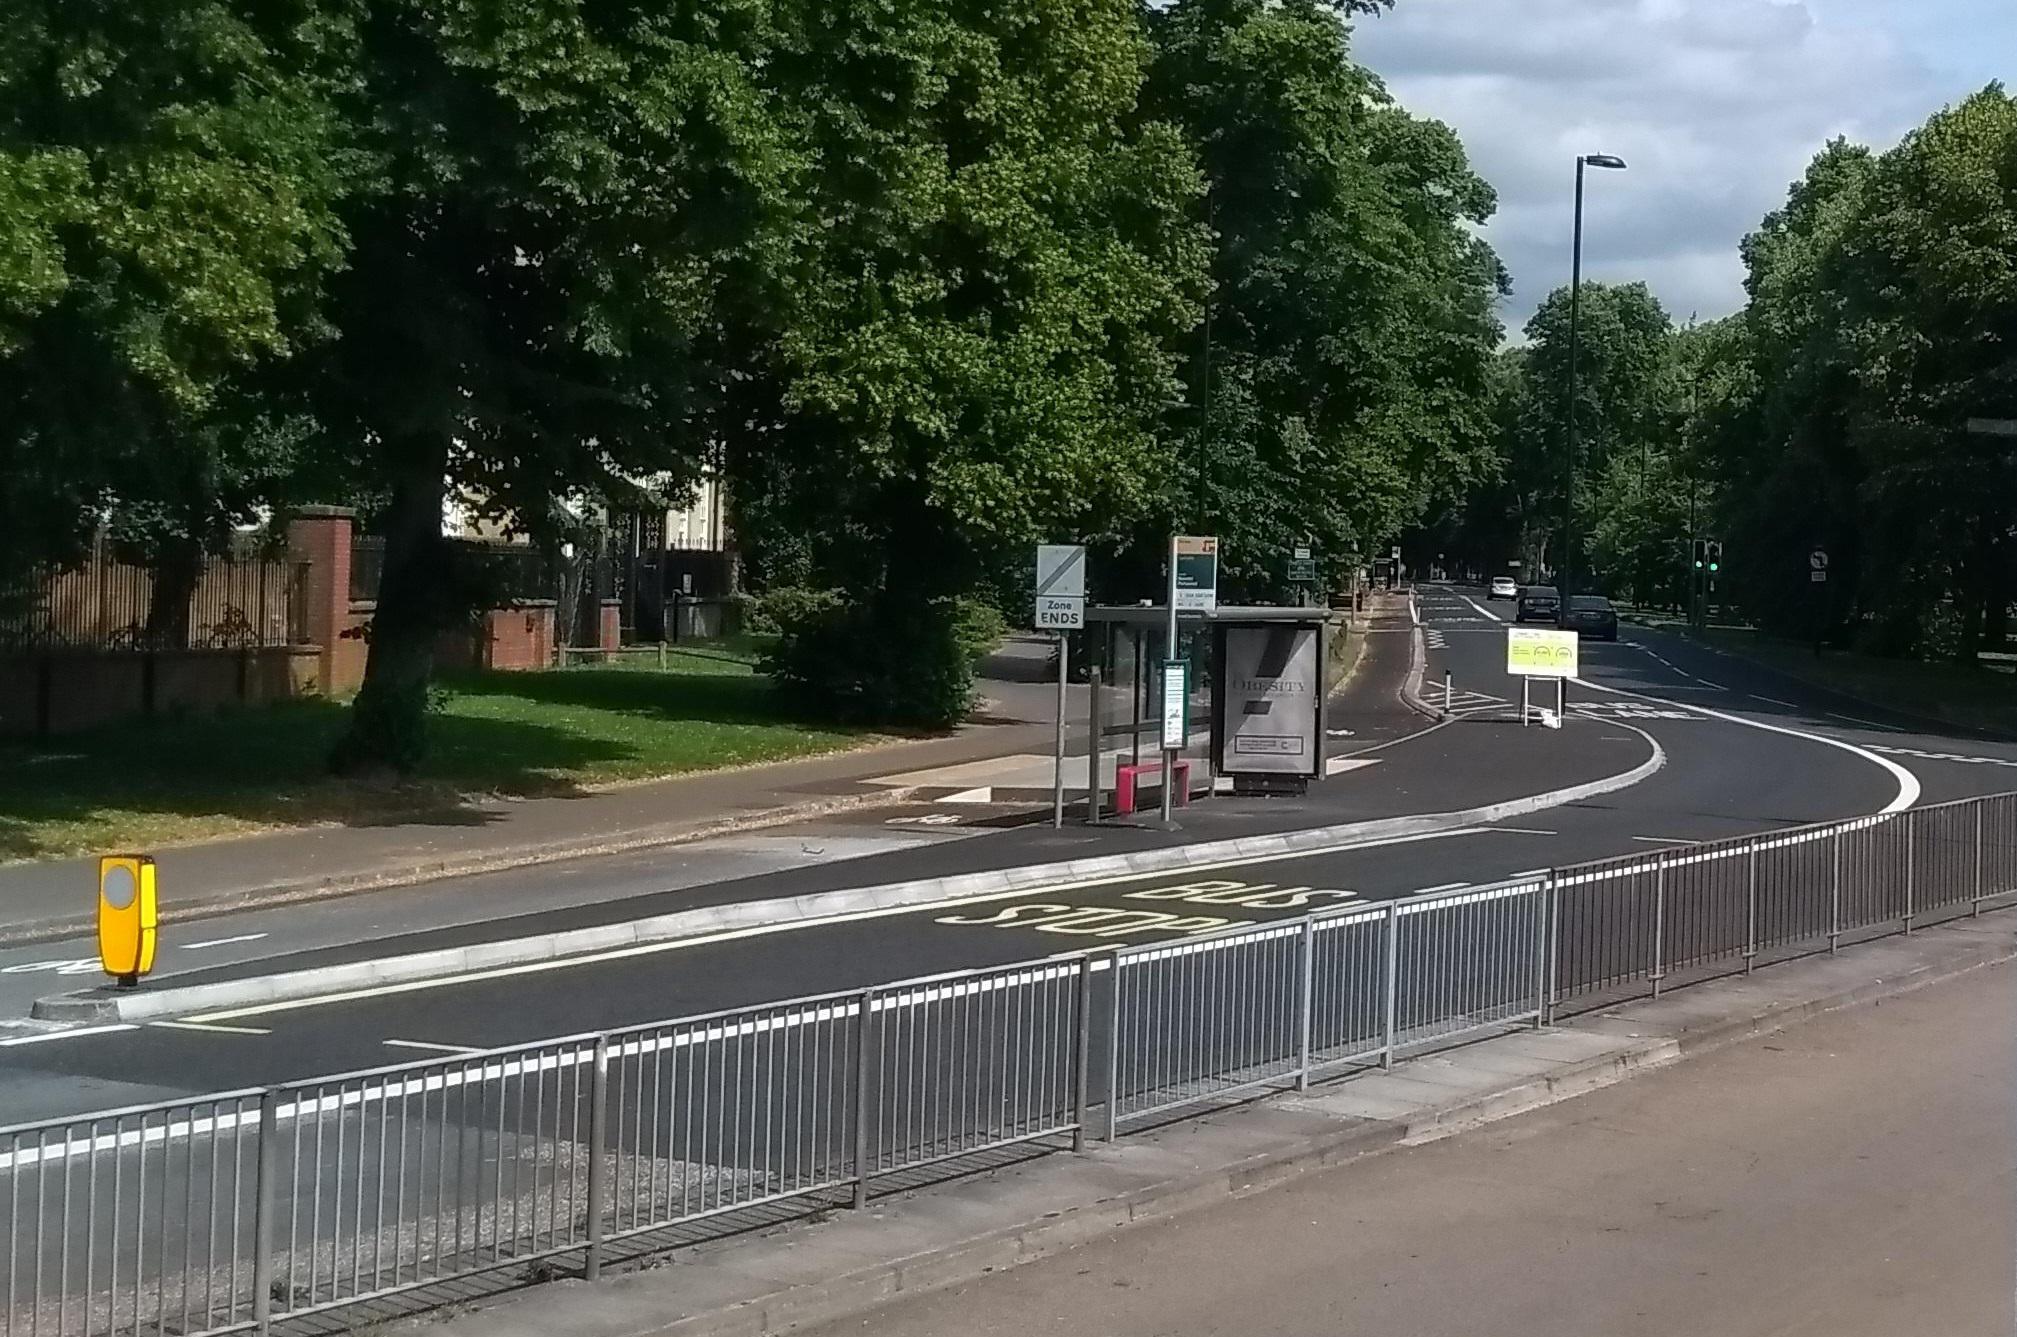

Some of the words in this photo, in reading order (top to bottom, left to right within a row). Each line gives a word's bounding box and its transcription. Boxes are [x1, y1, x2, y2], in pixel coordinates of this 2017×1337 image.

[1047, 600, 1072, 610] Zone
[1041, 612, 1079, 625] ENDS
[1121, 880, 1359, 909] BUS
[933, 903, 1231, 936] STOP
